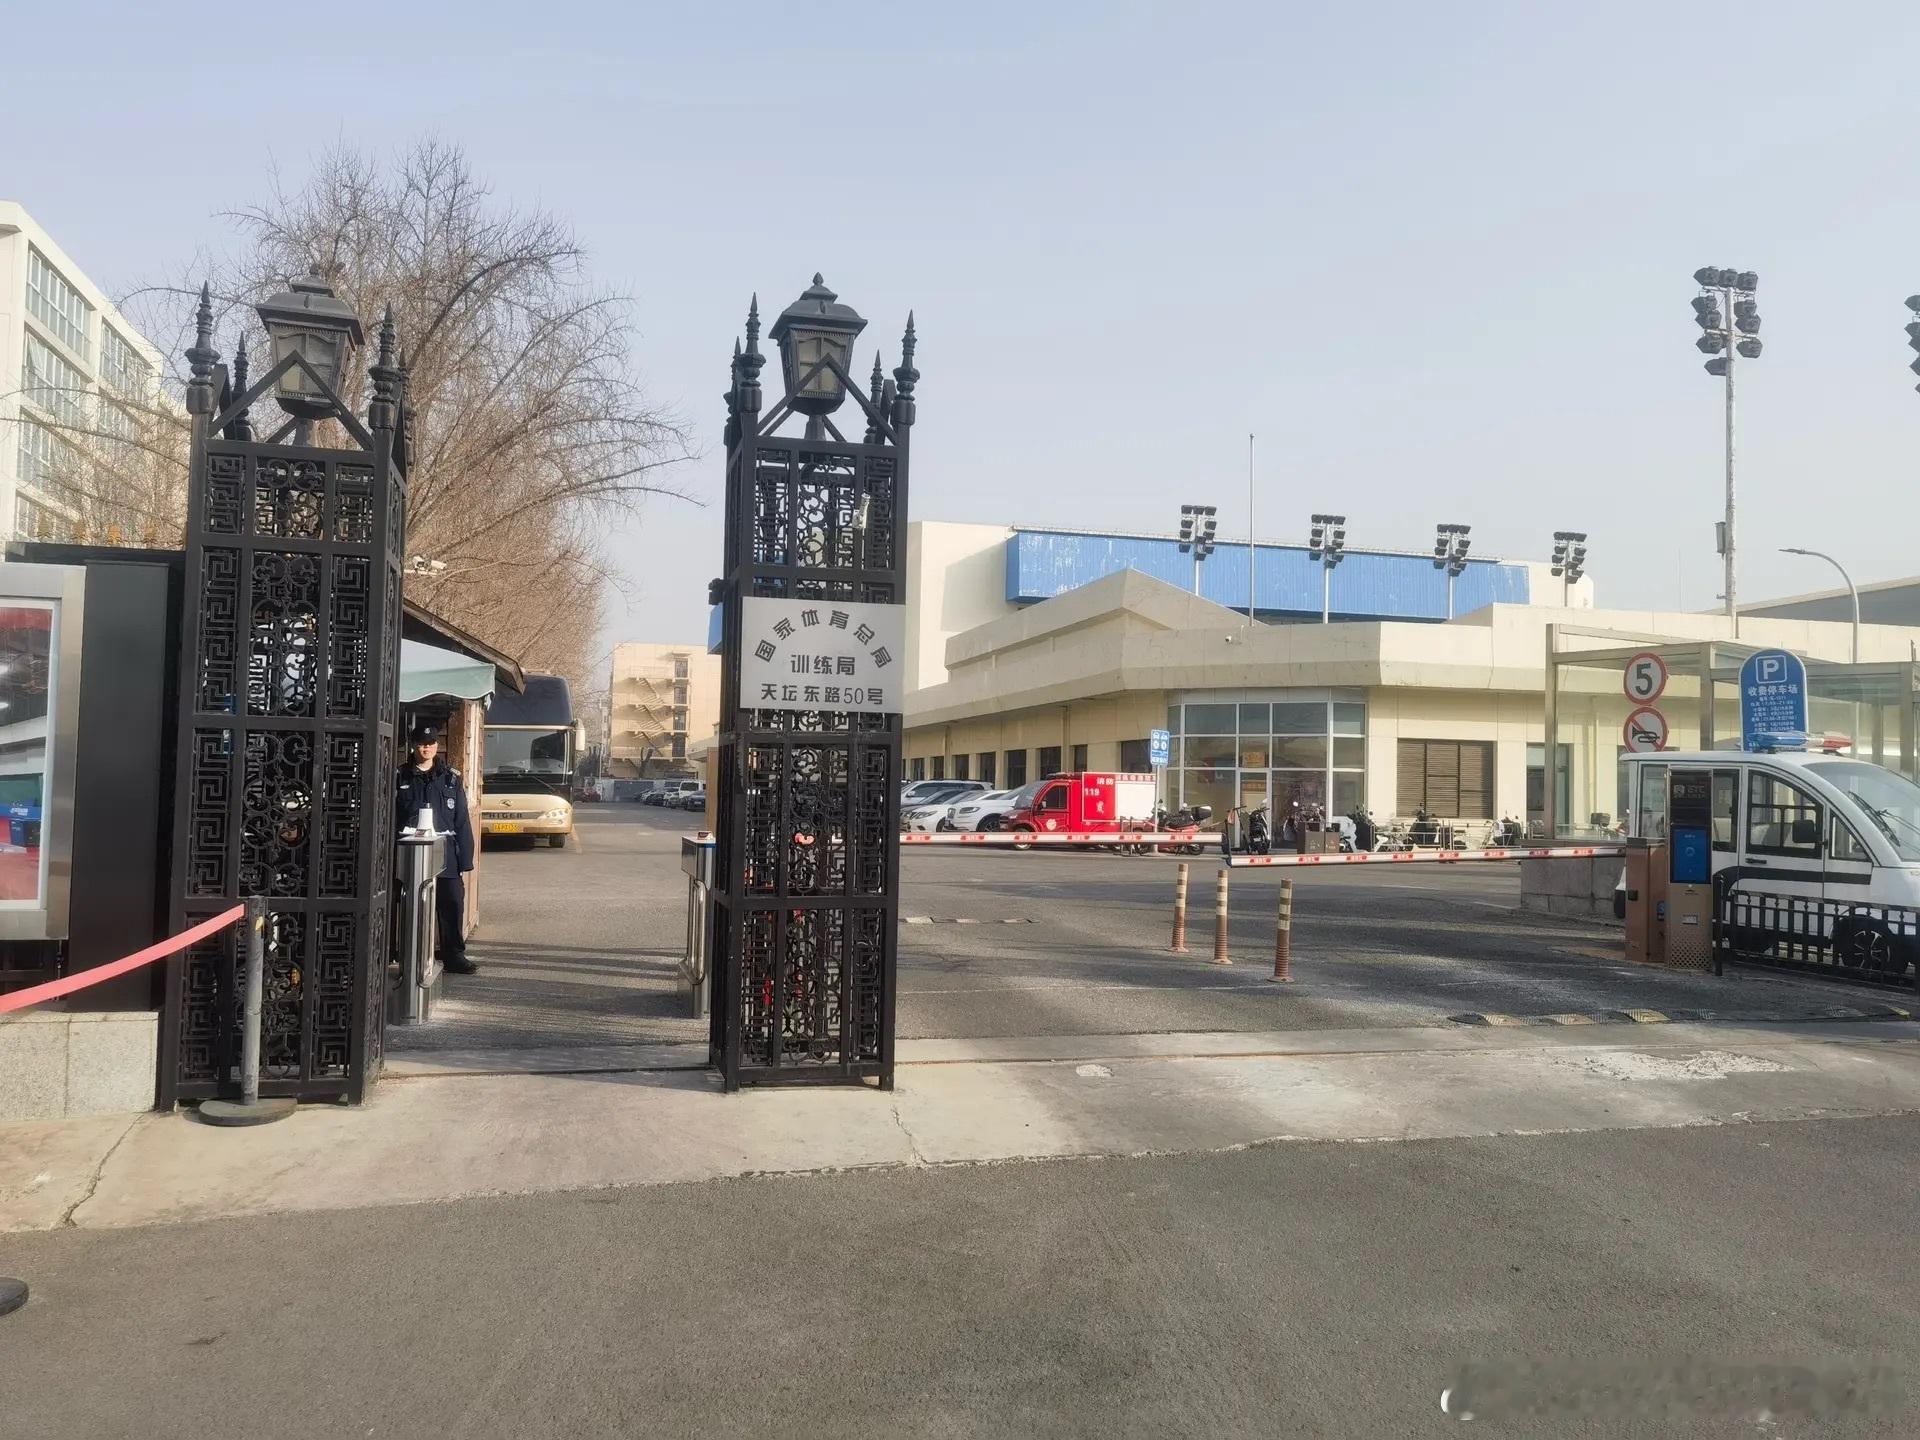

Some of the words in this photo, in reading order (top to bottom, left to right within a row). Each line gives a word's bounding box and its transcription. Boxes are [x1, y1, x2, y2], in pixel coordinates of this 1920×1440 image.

[754, 608, 892, 668] 国家体育总局
[790, 654, 856, 675] 训练局
[1763, 660, 1779, 680] P
[1635, 663, 1653, 695] 5
[761, 683, 883, 705] 天坛东路50号
[1747, 685, 1798, 696] 收费停车场
[1084, 788, 1100, 796] 119
